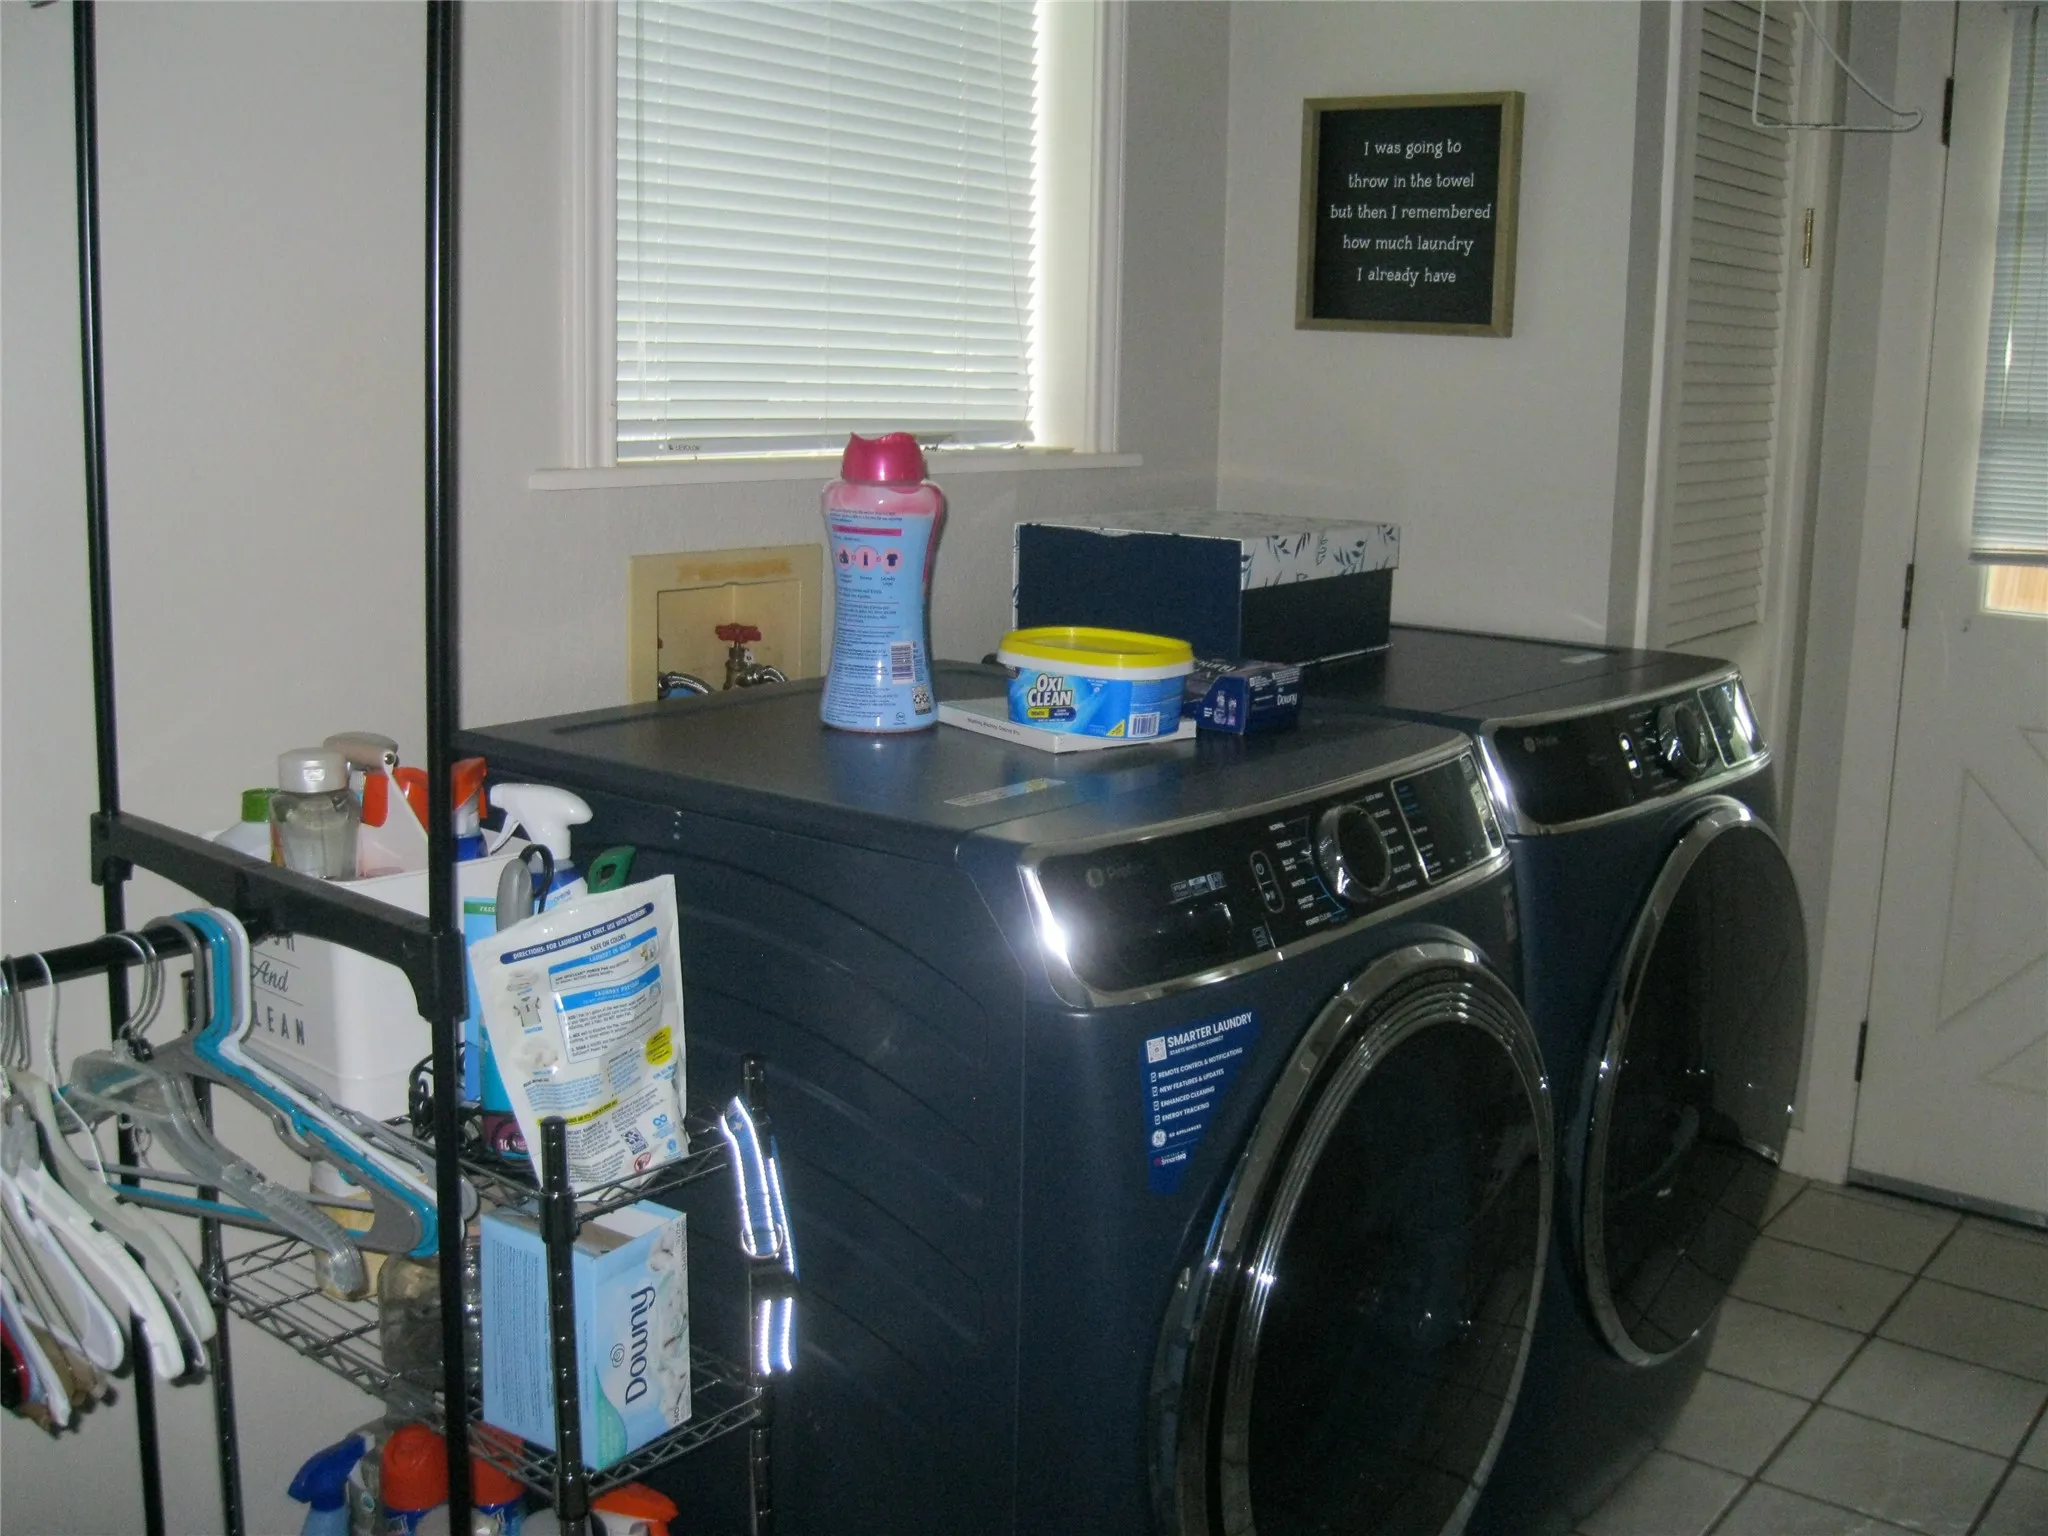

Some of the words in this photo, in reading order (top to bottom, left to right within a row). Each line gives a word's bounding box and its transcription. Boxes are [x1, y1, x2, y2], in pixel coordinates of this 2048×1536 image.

[1364, 141, 1369, 156] I
[1374, 144, 1401, 154] was
[1405, 141, 1443, 159] going
[1447, 139, 1462, 153] to
[1348, 173, 1389, 188] throw
[1393, 175, 1406, 188] in
[1410, 173, 1432, 188] the
[1436, 172, 1475, 188] towel
[1330, 204, 1353, 219] but
[1358, 205, 1387, 219] then
[1391, 205, 1396, 220] I
[1401, 203, 1491, 219] remembered
[1343, 234, 1371, 249] how
[1375, 235, 1413, 250] much
[1417, 235, 1474, 256] laundry
[1357, 267, 1362, 281] I
[1368, 267, 1419, 287] already
[1424, 268, 1457, 283] have
[1036, 673, 1063, 692] OXI
[1028, 688, 1072, 706] CLEAN
[513, 947, 546, 960] DIRECTIONS:
[546, 942, 558, 951] FOR
[558, 935, 581, 947] LAUNDRY
[583, 931, 591, 939] USE
[251, 960, 289, 992] And
[252, 1000, 305, 1046] LEAN
[1167, 1026, 1212, 1048] SMARTER
[1213, 1012, 1252, 1034] LAUNDRY
[1158, 1067, 1180, 1078] REMOTE
[1180, 1060, 1203, 1073] CONTROL
[1159, 1084, 1173, 1093] NEW
[1173, 1077, 1198, 1090] FEATURES
[1203, 1068, 1224, 1080] UPDATES
[1160, 1095, 1190, 1108] ENHANCED
[1190, 1086, 1215, 1100] CLEANING
[1162, 1111, 1183, 1122] ENERGY
[1184, 1102, 1210, 1115] TRACKING
[1176, 1124, 1202, 1136] APPLIANCES
[1161, 1152, 1187, 1166] SmartHQ
[625, 1282, 656, 1405] Downy
